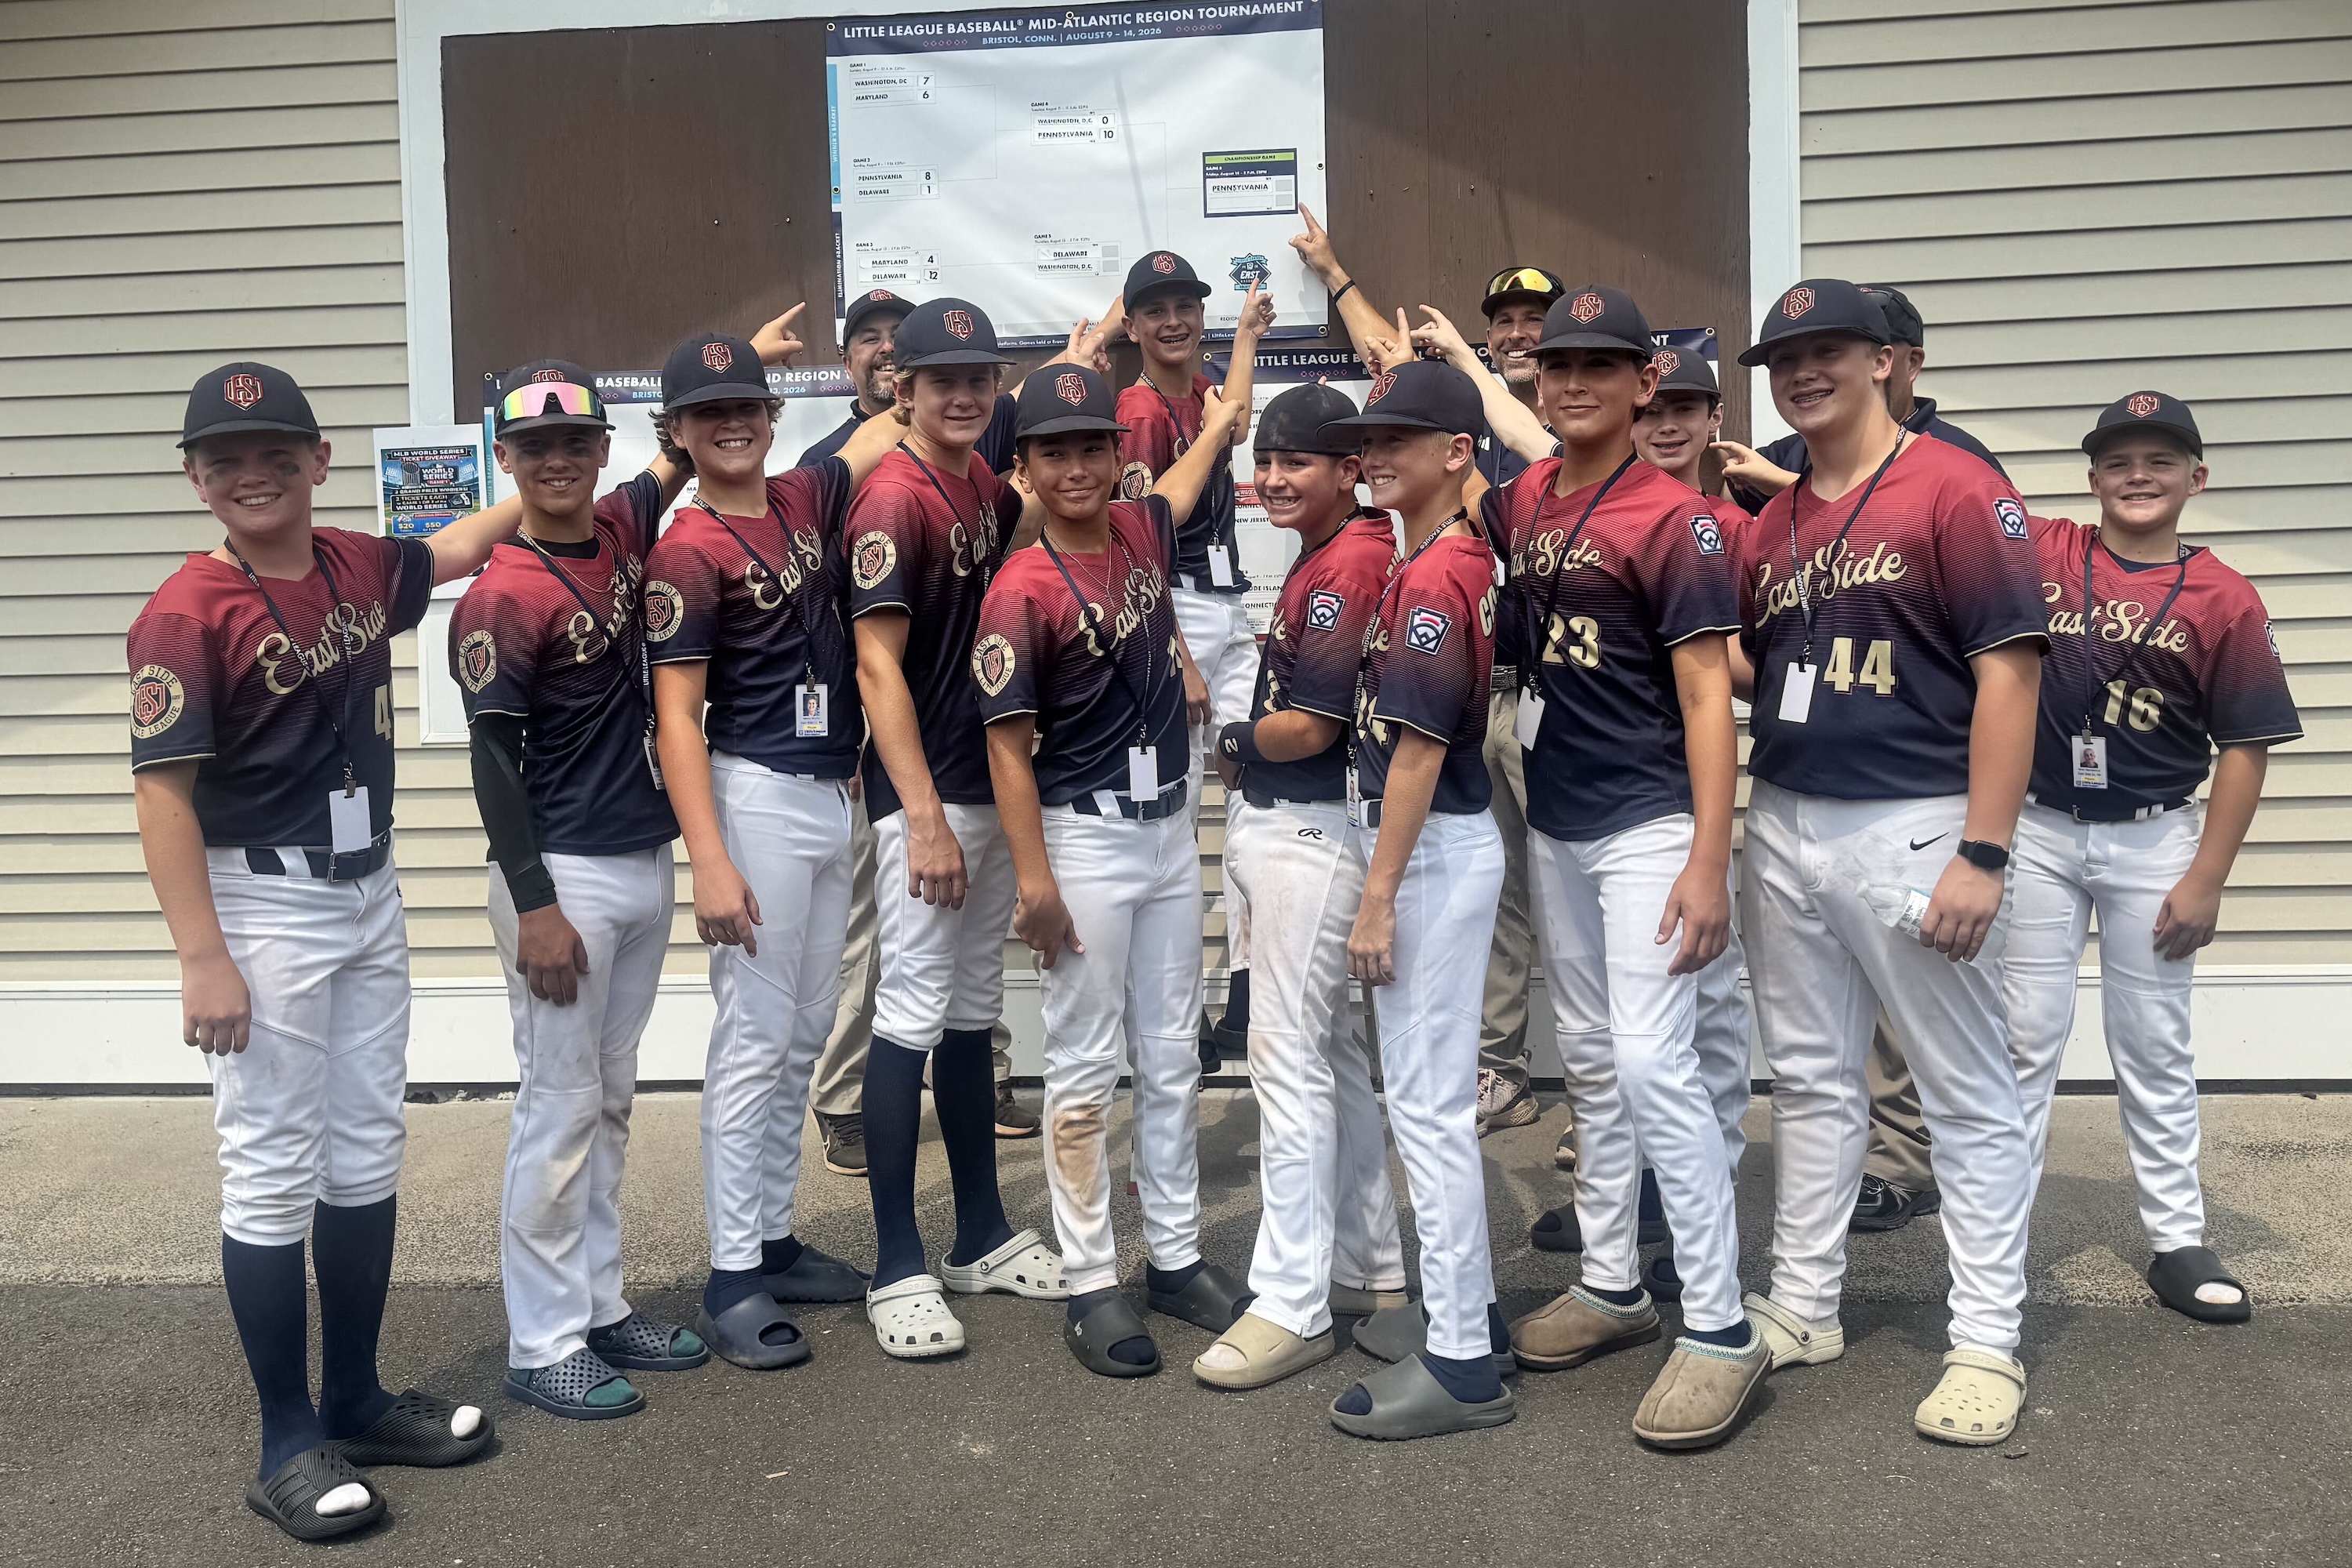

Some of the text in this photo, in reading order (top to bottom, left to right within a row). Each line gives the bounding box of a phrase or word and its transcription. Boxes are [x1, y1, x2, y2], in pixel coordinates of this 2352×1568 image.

[844, 26, 885, 38] LITTLE
[889, 24, 943, 37] LEAGUE
[1029, 13, 1132, 31] MID-ATLANTIC
[1136, 9, 1193, 24] REGION
[1198, 1, 1303, 19] TOURNAMENT
[982, 36, 1022, 45] BRISTOL,
[1025, 34, 1057, 43] CONN.
[1066, 31, 1105, 41] AUGUST
[1138, 27, 1162, 36] 2026
[924, 77, 930, 85] 7
[923, 91, 929, 100] 6
[1104, 130, 1113, 139] 10
[925, 172, 931, 180] 8
[1212, 183, 1269, 192] PENNSYLVANIA
[927, 255, 934, 263] 4
[929, 270, 938, 280] 12
[1240, 270, 1261, 279] EAST
[1254, 355, 1288, 367] ITTLE
[1293, 354, 1348, 366] LEAGUE
[786, 370, 841, 383] REGION
[1441, 516, 1456, 528] LITTLE
[854, 535, 869, 557] EAST
[1536, 528, 1604, 577] Side
[1815, 538, 1907, 600] Side
[655, 582, 679, 600] SIDE
[746, 554, 802, 610] East
[659, 615, 681, 640] LEAGUE
[1078, 591, 1140, 656] East
[2102, 600, 2189, 653] Side
[459, 633, 475, 659] EAST
[974, 638, 991, 661] EAST
[1541, 612, 1601, 670] 23
[148, 666, 178, 687] SIDE
[1824, 637, 1898, 696] 44
[375, 684, 392, 741] 4
[2103, 680, 2165, 733] 16
[149, 706, 180, 735] LEAGUE
